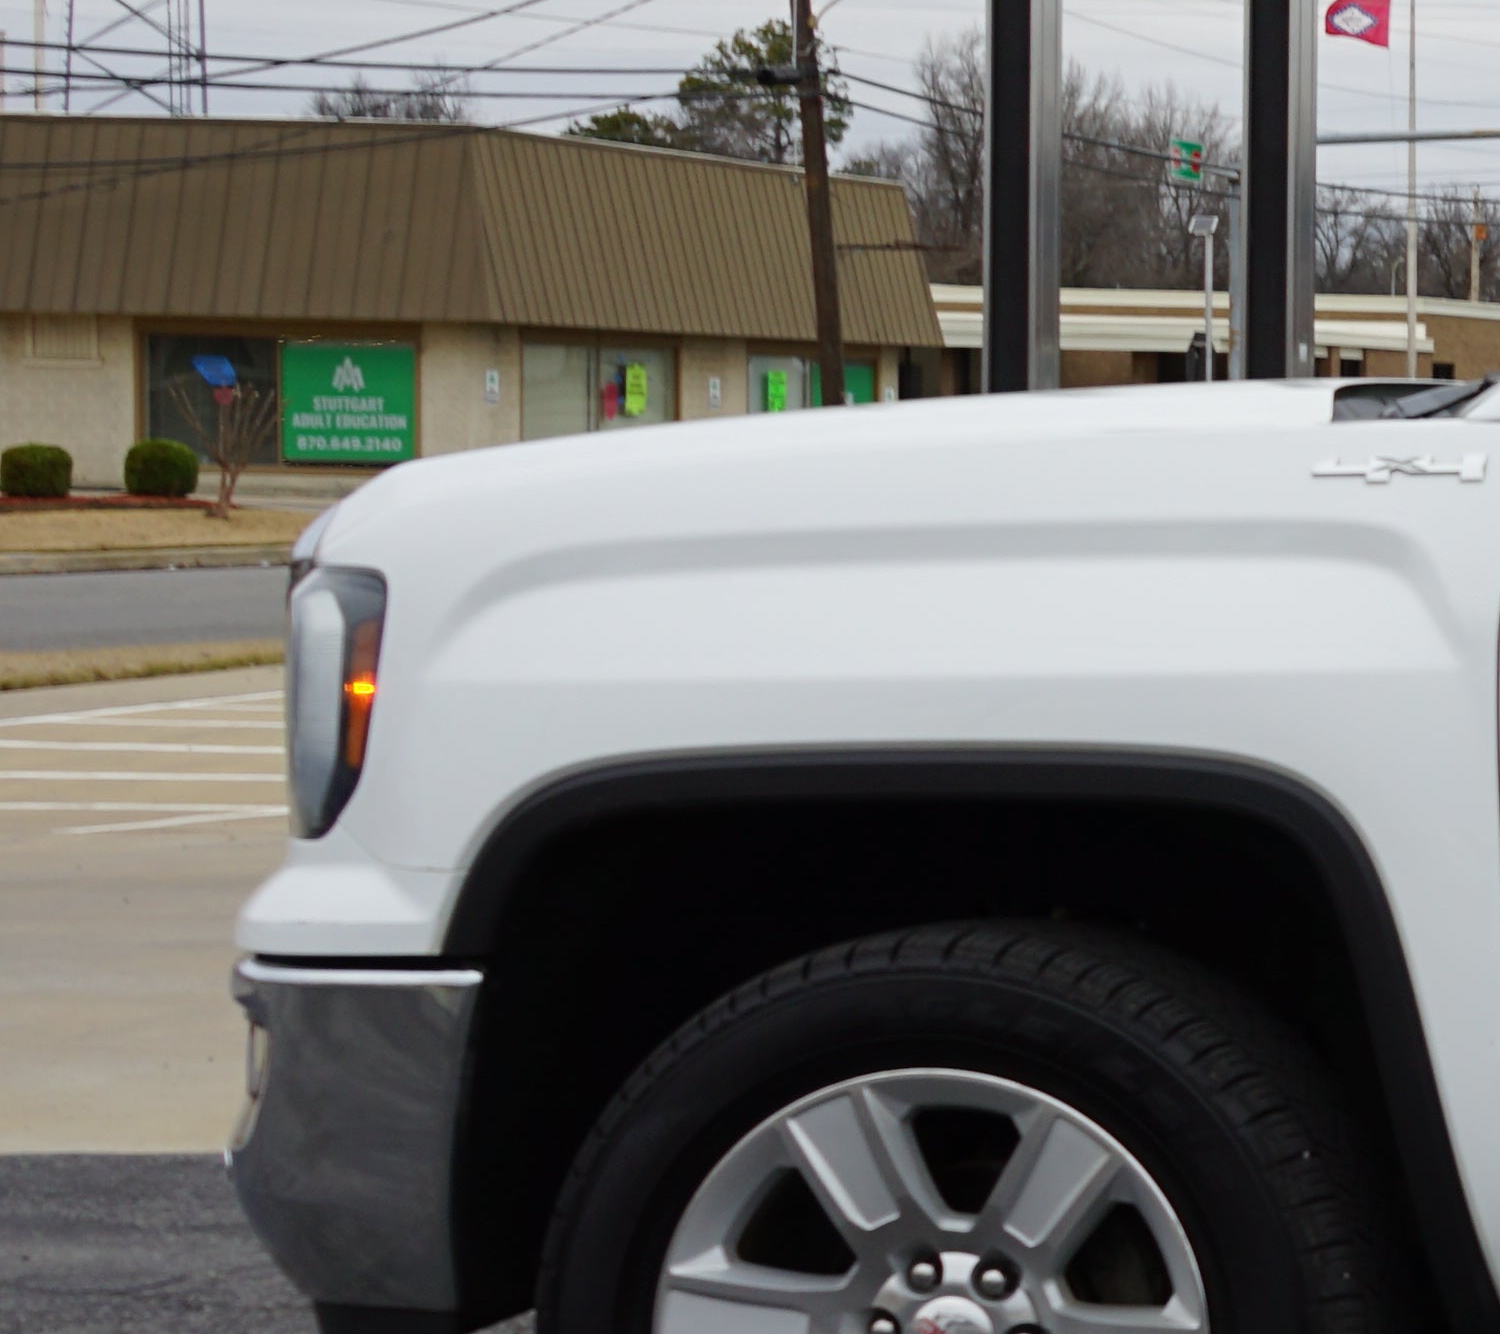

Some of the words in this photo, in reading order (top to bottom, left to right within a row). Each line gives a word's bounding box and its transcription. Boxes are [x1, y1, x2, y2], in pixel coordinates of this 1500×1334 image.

[312, 396, 385, 413] STUTTGART
[292, 412, 332, 428] ADULT
[336, 414, 407, 430] EDUCATION
